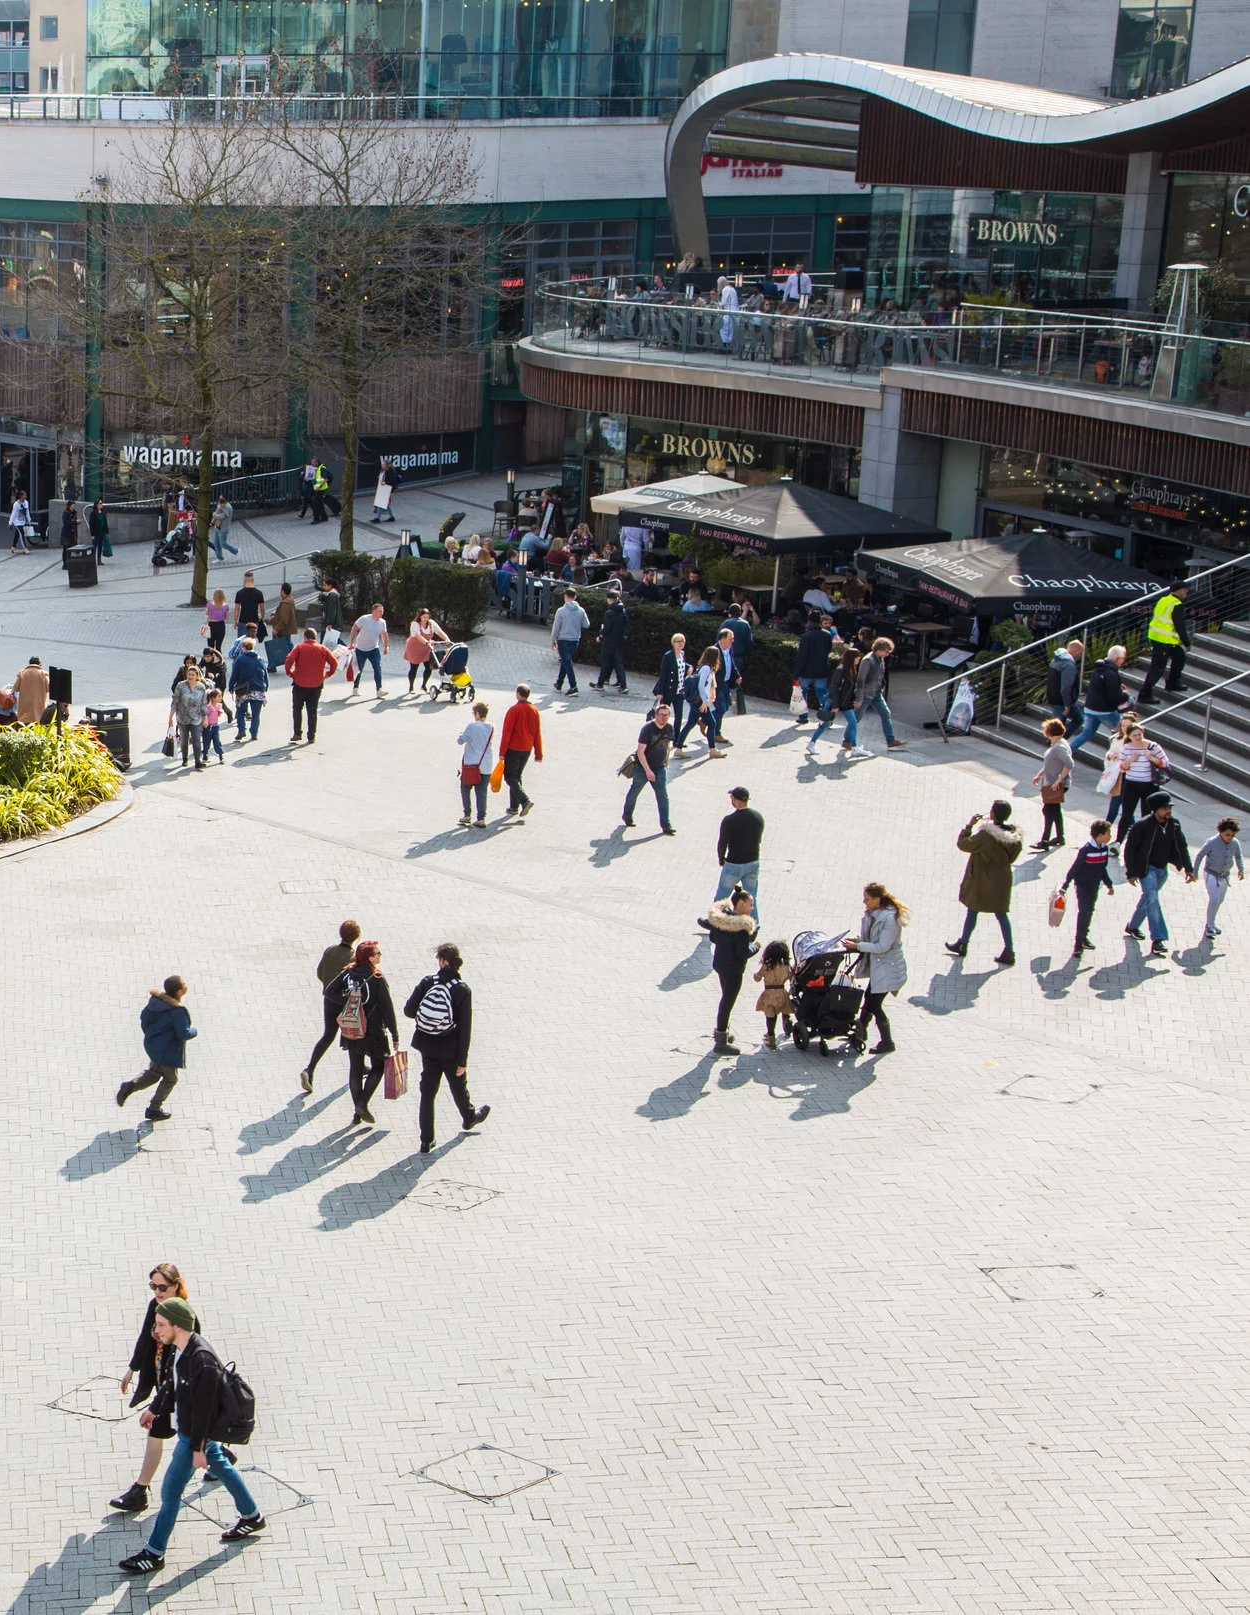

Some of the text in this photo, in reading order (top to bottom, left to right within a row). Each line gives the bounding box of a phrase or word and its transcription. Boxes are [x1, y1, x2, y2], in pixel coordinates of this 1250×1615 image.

[732, 168, 784, 178] ITALIAN
[977, 219, 1057, 246] BROWNS
[662, 433, 755, 465] BROWNS
[1131, 480, 1191, 511] Chaophraya
[640, 517, 670, 531] Chaophraya
[667, 500, 766, 527] Chaophraya
[699, 528, 712, 537] THAI
[713, 530, 749, 545] RESTAURANT
[755, 540, 768, 549] BAR
[904, 547, 984, 581] Chaophraya
[1008, 574, 1163, 595] Chaophraya
[1013, 601, 1062, 614] Chaophraya
